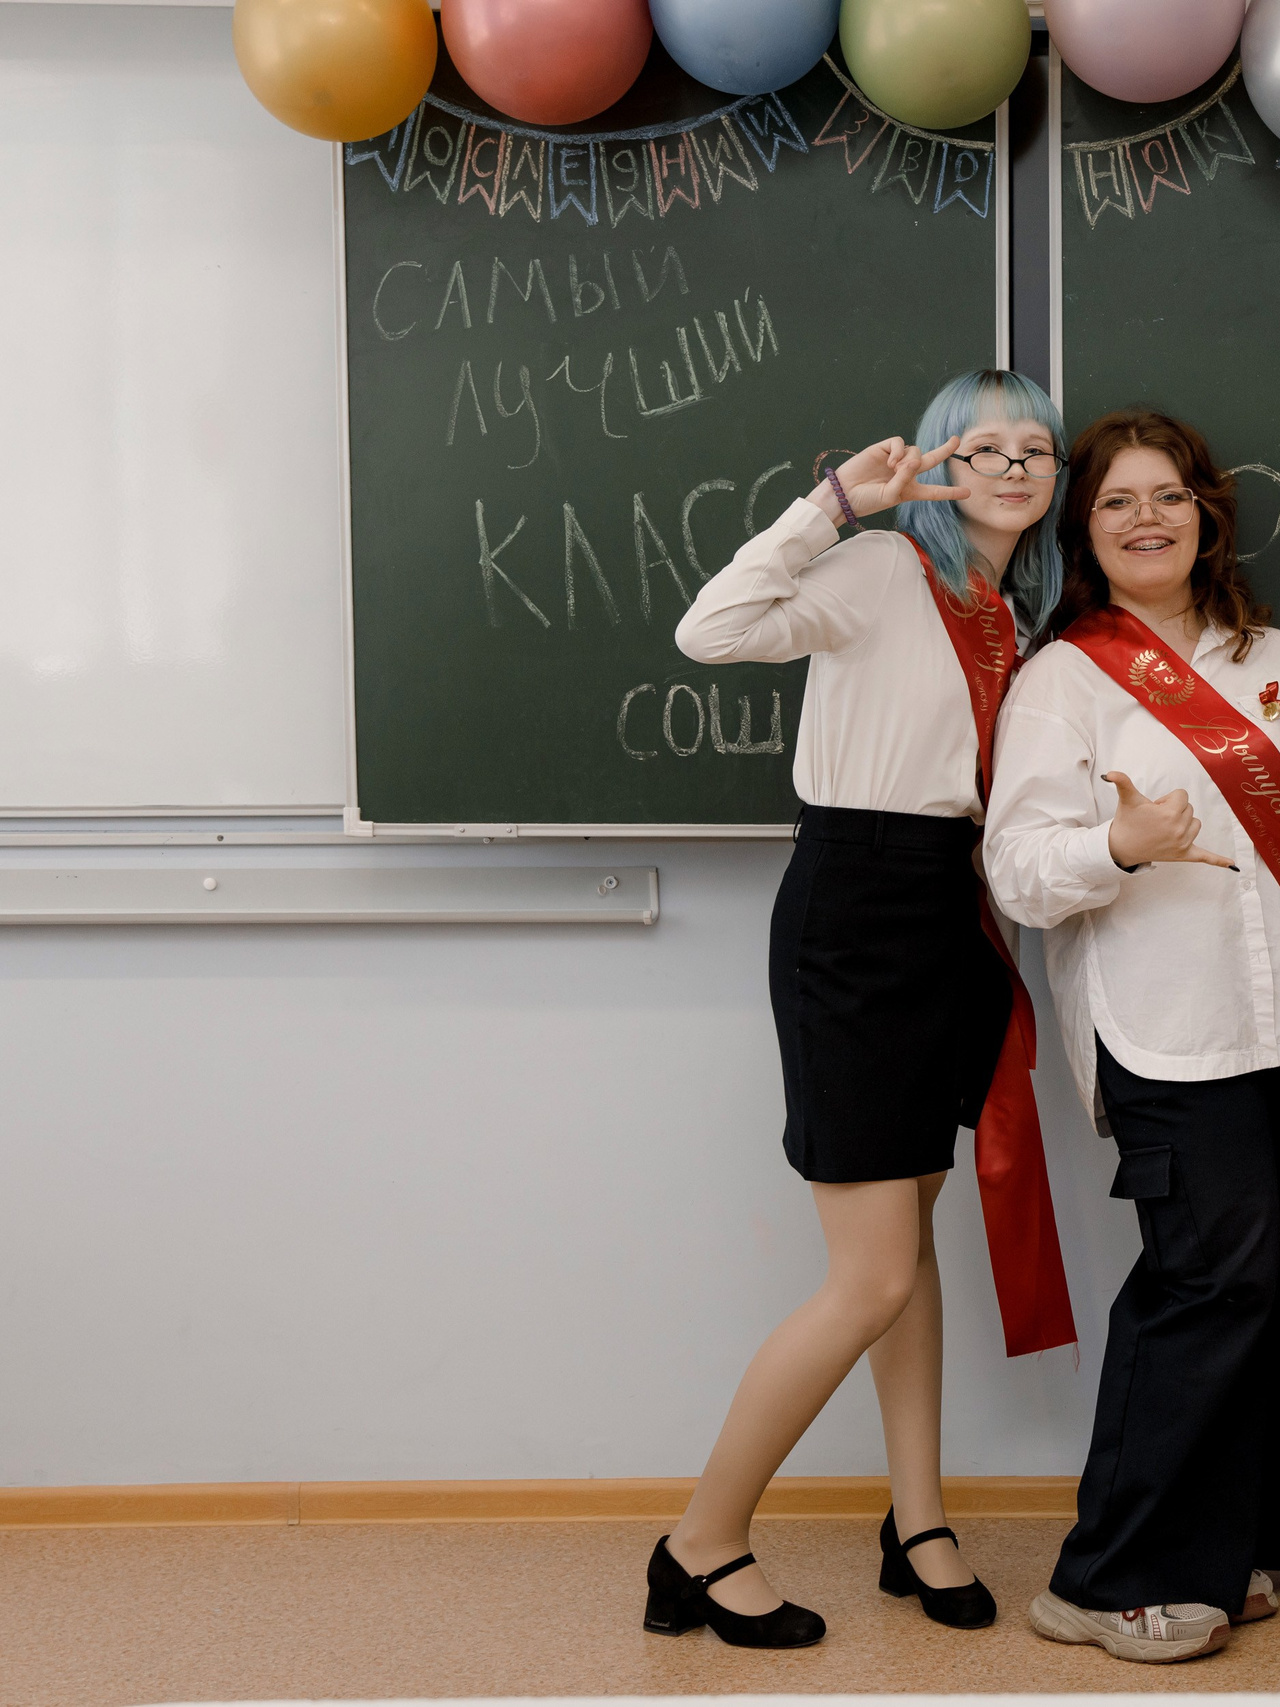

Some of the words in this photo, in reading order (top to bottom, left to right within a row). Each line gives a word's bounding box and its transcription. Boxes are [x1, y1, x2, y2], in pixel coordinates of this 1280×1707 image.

[372, 245, 690, 342] САМЫЙ
[446, 286, 780, 469] ЛУЧШИЙ
[616, 683, 785, 761] СОШ
